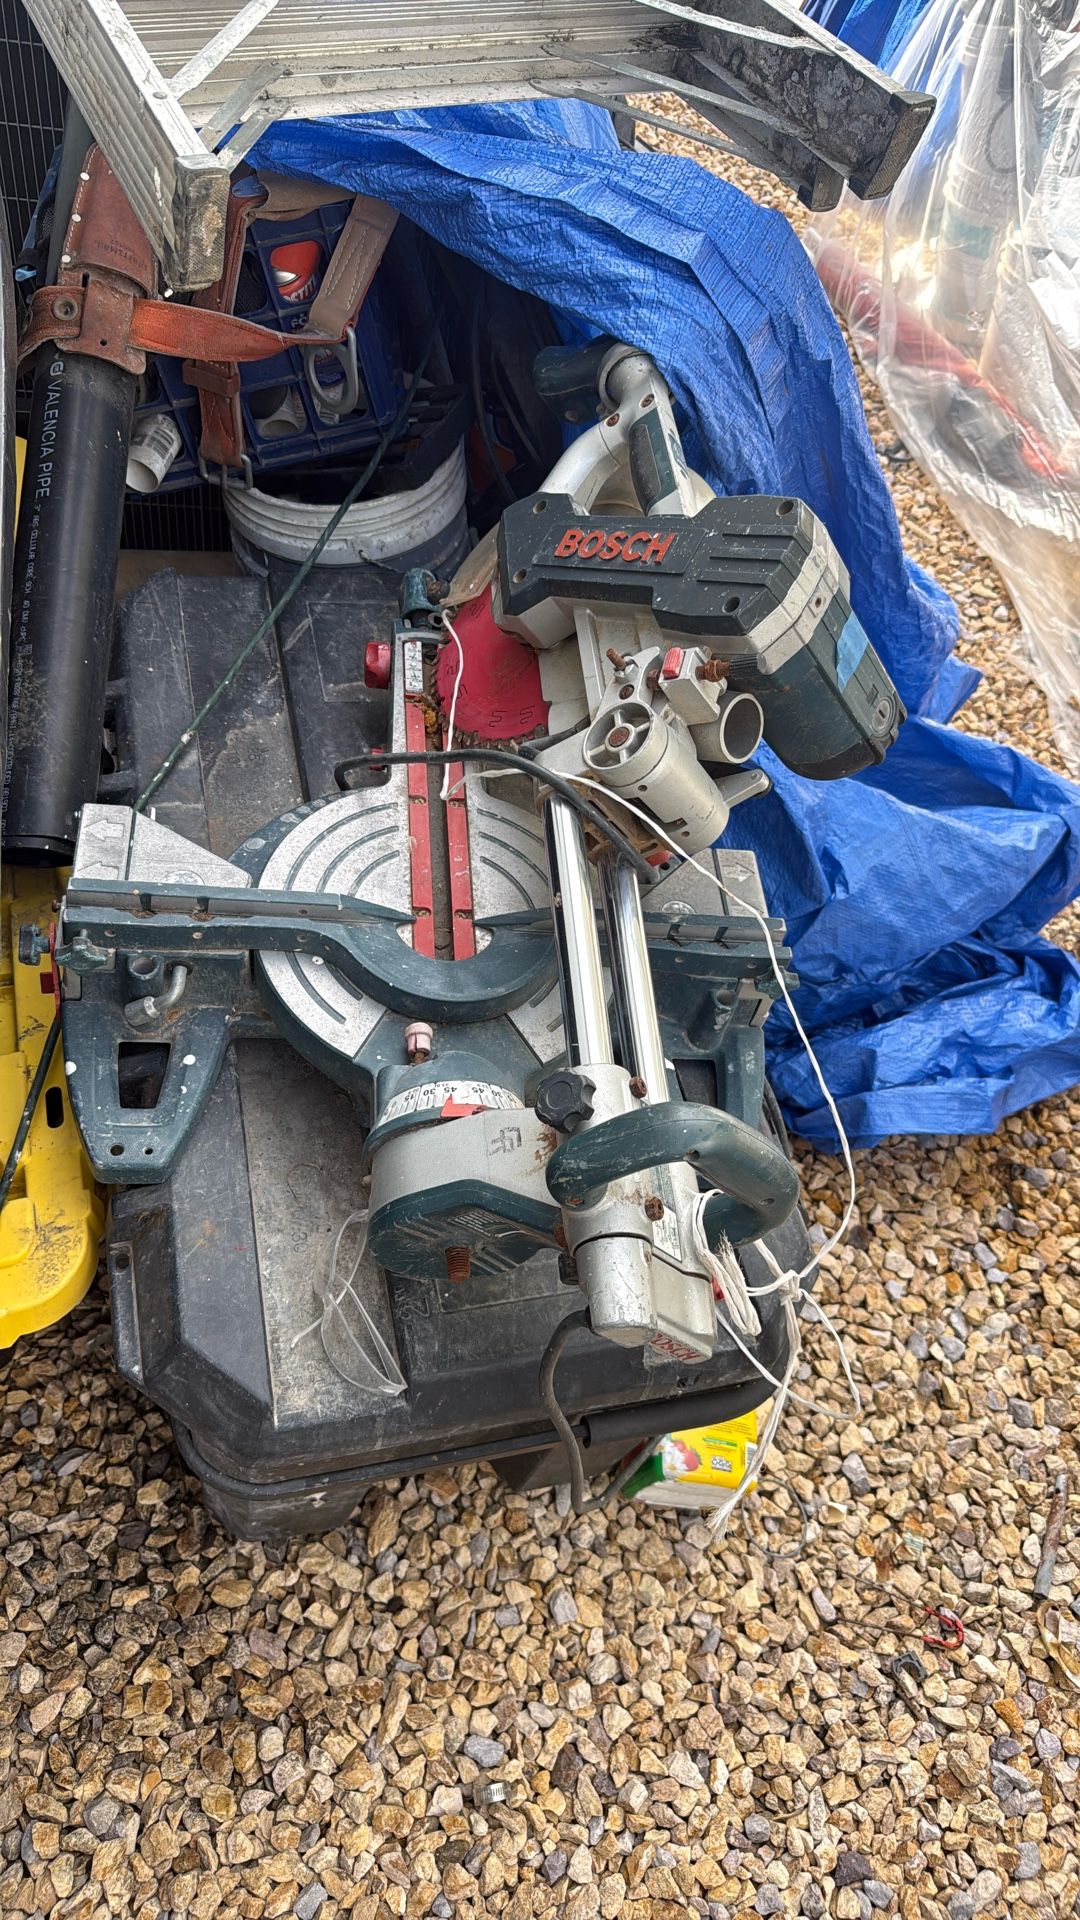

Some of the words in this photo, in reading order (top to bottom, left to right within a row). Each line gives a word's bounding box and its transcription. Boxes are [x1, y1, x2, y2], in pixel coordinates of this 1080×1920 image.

[40, 379, 63, 458] VALENCIA
[36, 462, 53, 497] PIPE
[554, 528, 677, 565] BOSCH
[404, 1094, 415, 1102] 15
[423, 1088, 436, 1096] 30
[444, 1086, 457, 1094] 45
